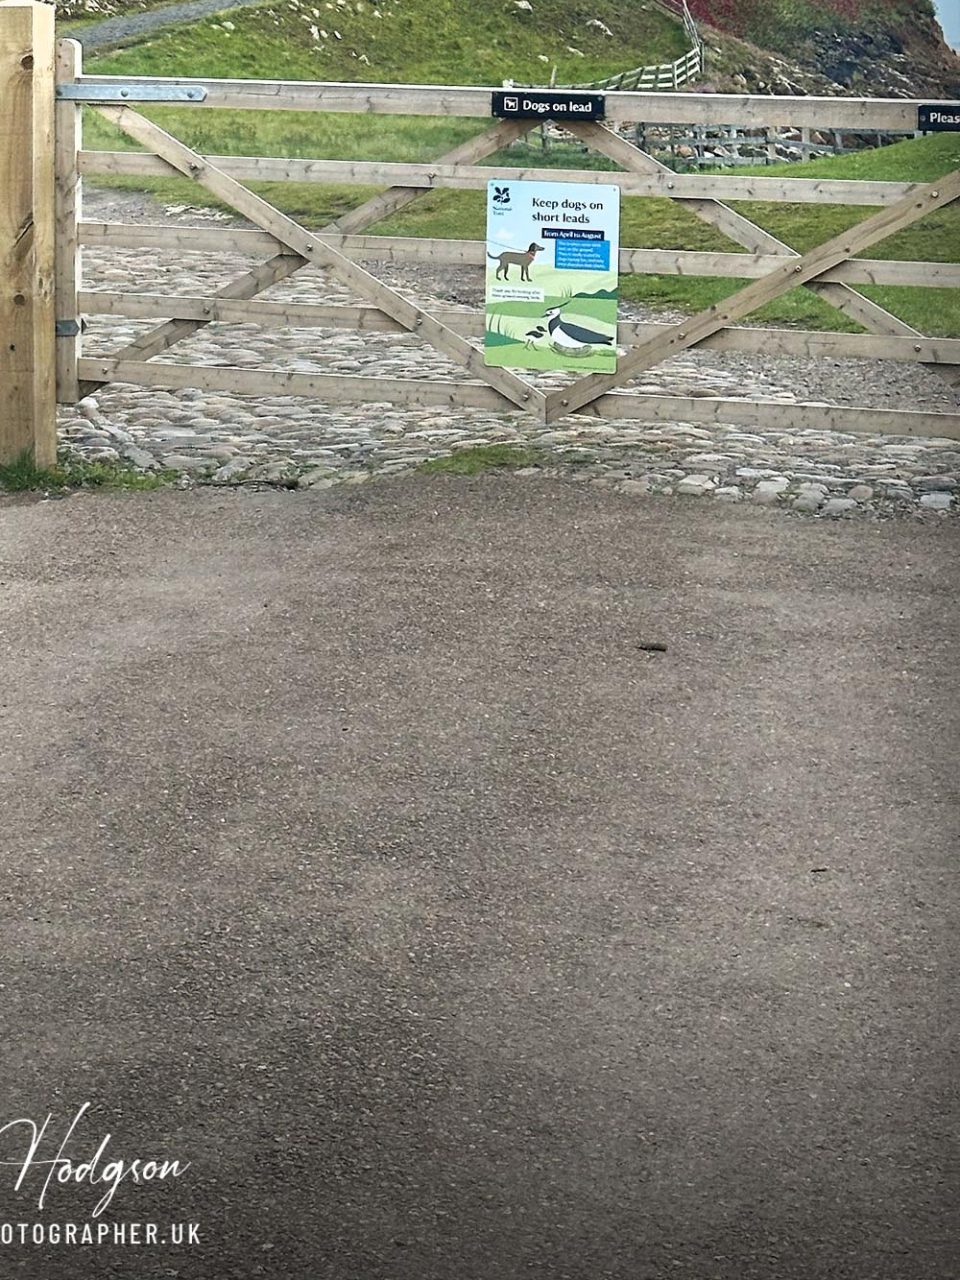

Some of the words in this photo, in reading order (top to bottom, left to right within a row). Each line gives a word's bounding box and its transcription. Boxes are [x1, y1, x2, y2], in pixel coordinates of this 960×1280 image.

[523, 100, 550, 113] Dogs
[552, 103, 567, 111] on
[569, 101, 592, 112] lead
[532, 198, 559, 210] Keep
[561, 199, 587, 211] dogs
[589, 202, 603, 210] on
[532, 212, 559, 222] short
[562, 213, 590, 224] leads
[560, 231, 573, 239] April
